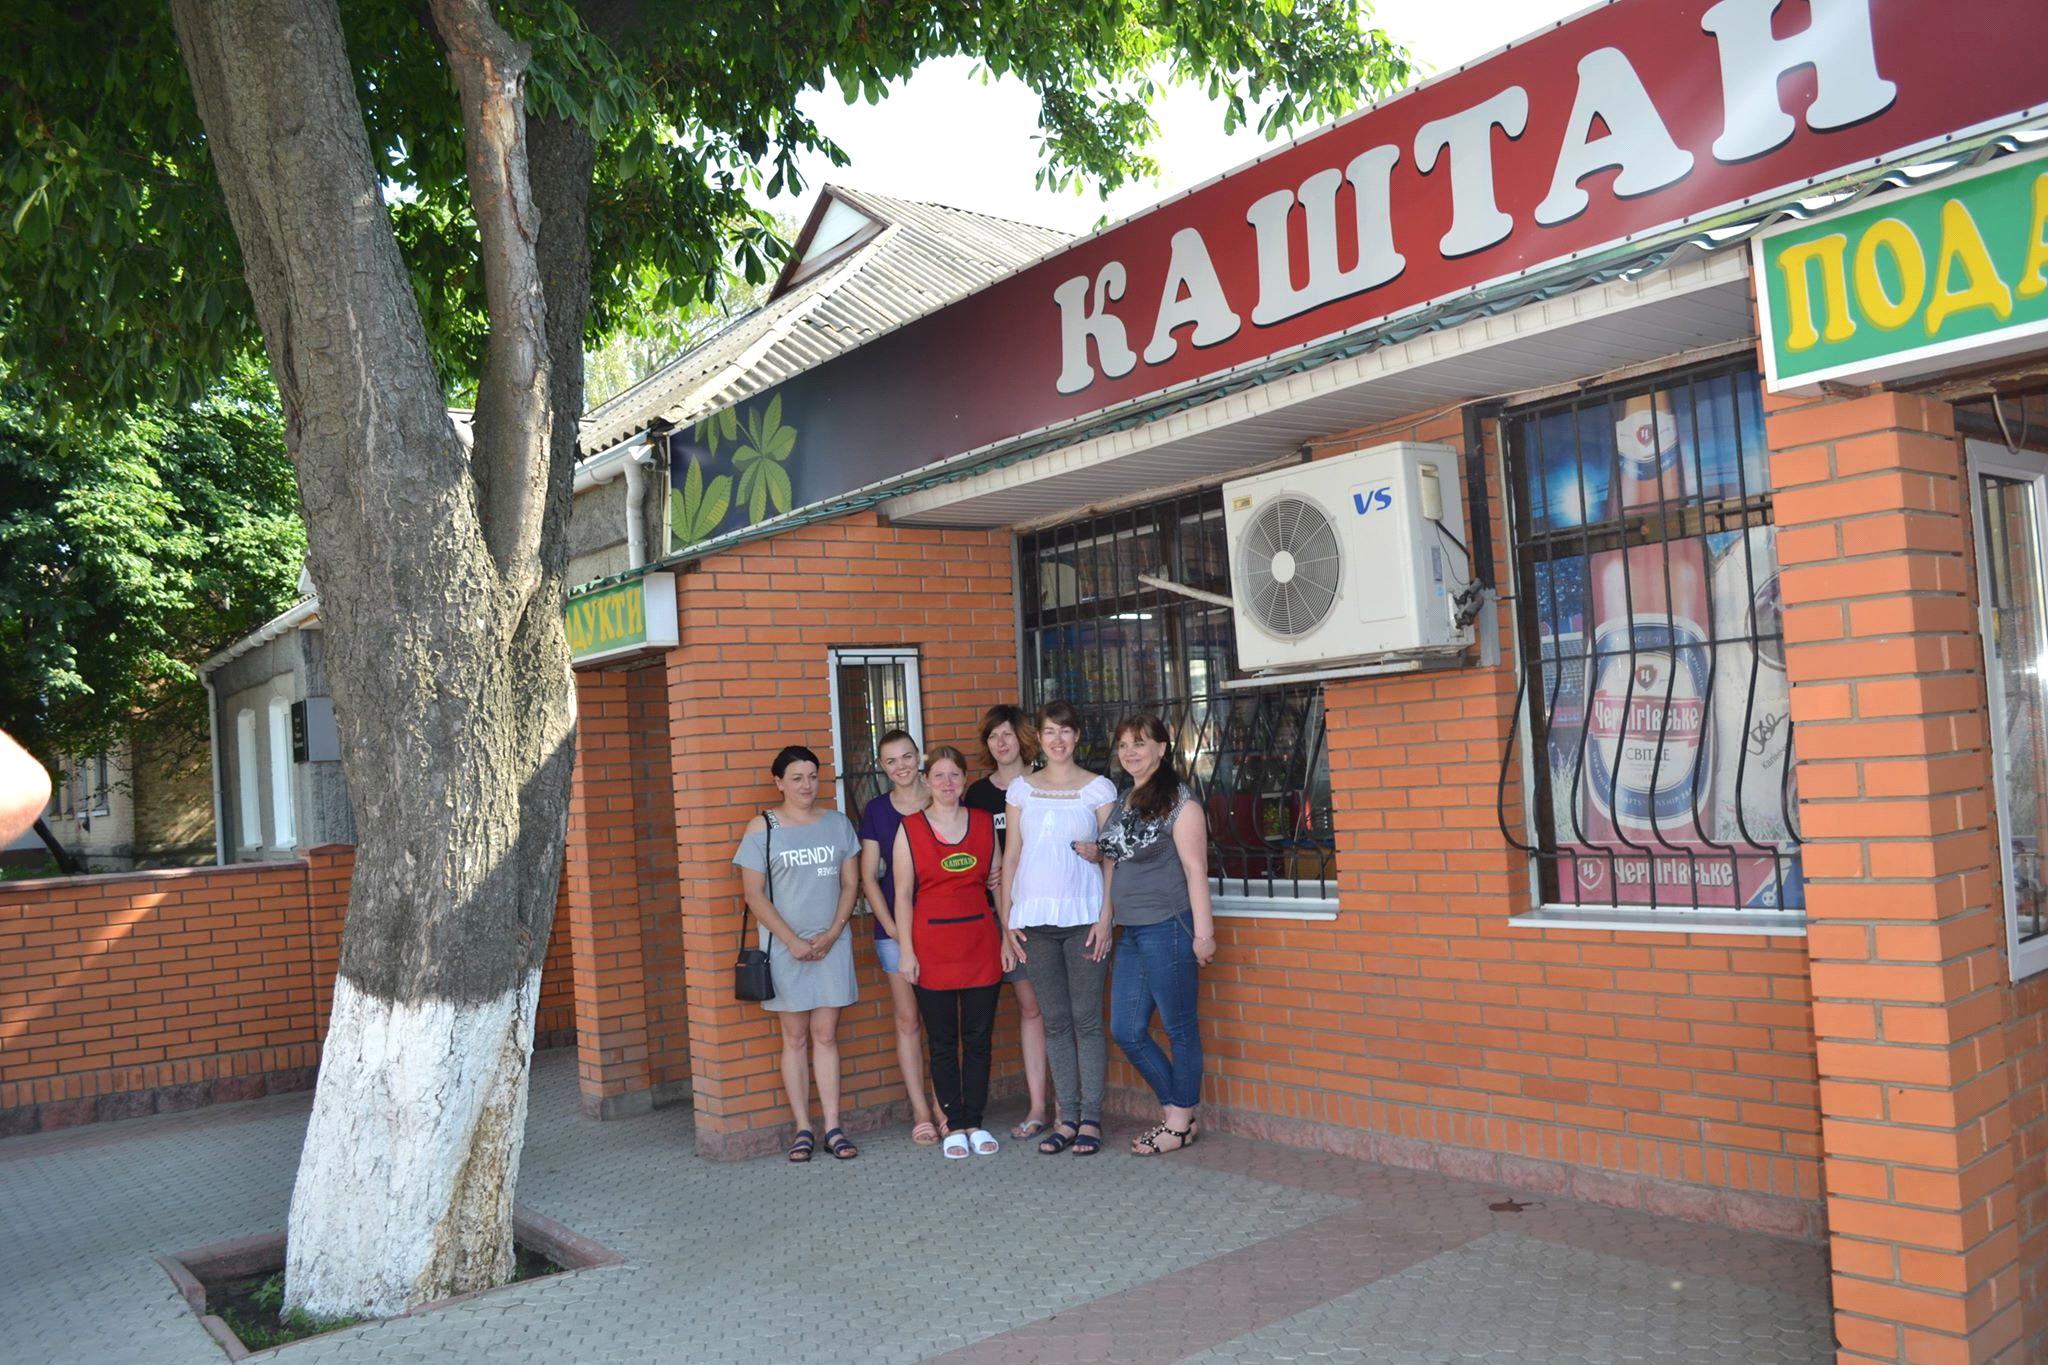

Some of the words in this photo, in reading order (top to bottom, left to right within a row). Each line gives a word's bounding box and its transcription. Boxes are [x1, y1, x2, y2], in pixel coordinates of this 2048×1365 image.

[1055, 0, 1897, 394] КАШТАН
[1353, 487, 1392, 515] VS
[1625, 747, 1670, 761] СВІТЕ
[779, 845, 835, 868] TRENDY
